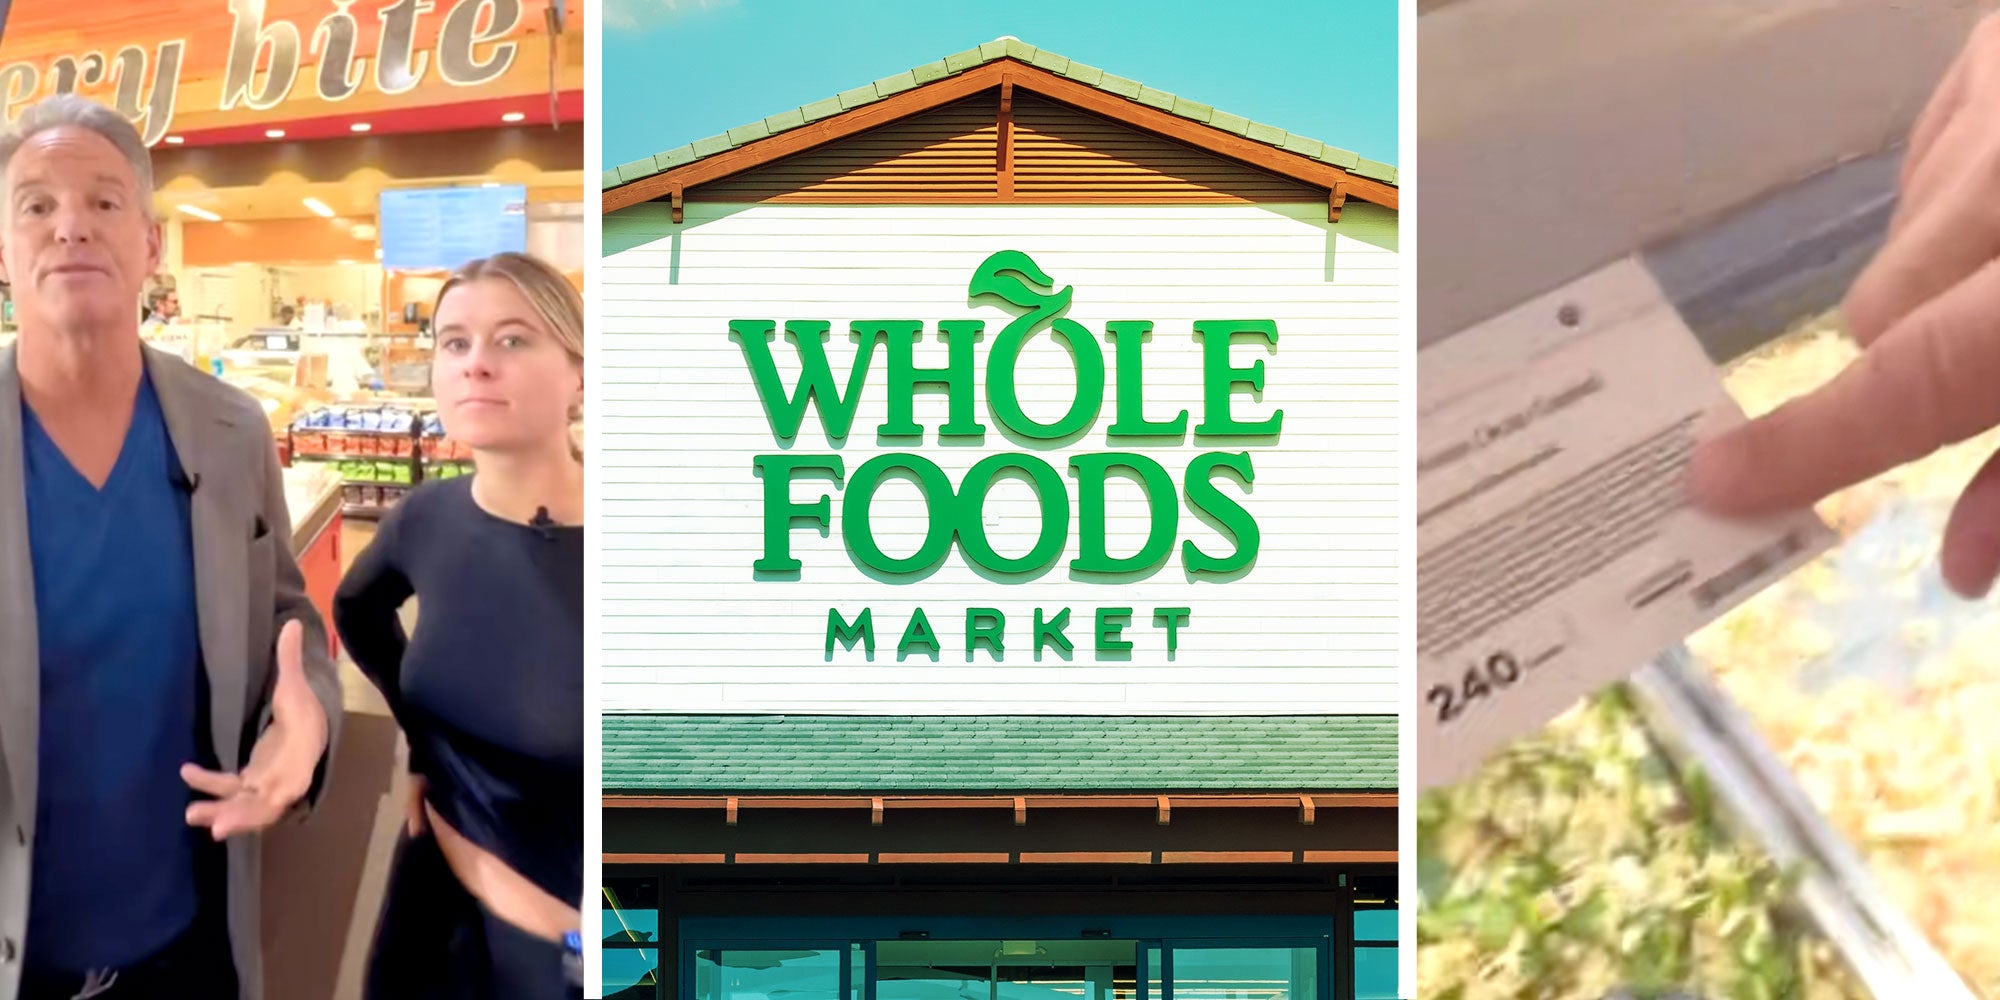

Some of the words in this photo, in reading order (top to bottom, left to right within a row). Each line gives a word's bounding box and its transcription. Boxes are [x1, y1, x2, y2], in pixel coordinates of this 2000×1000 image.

[218, 0, 523, 111] bite
[728, 285, 1284, 441] WHOLE
[753, 451, 1261, 576] FOODS
[825, 607, 1191, 656] MARKET
[1427, 652, 1519, 723] 240
